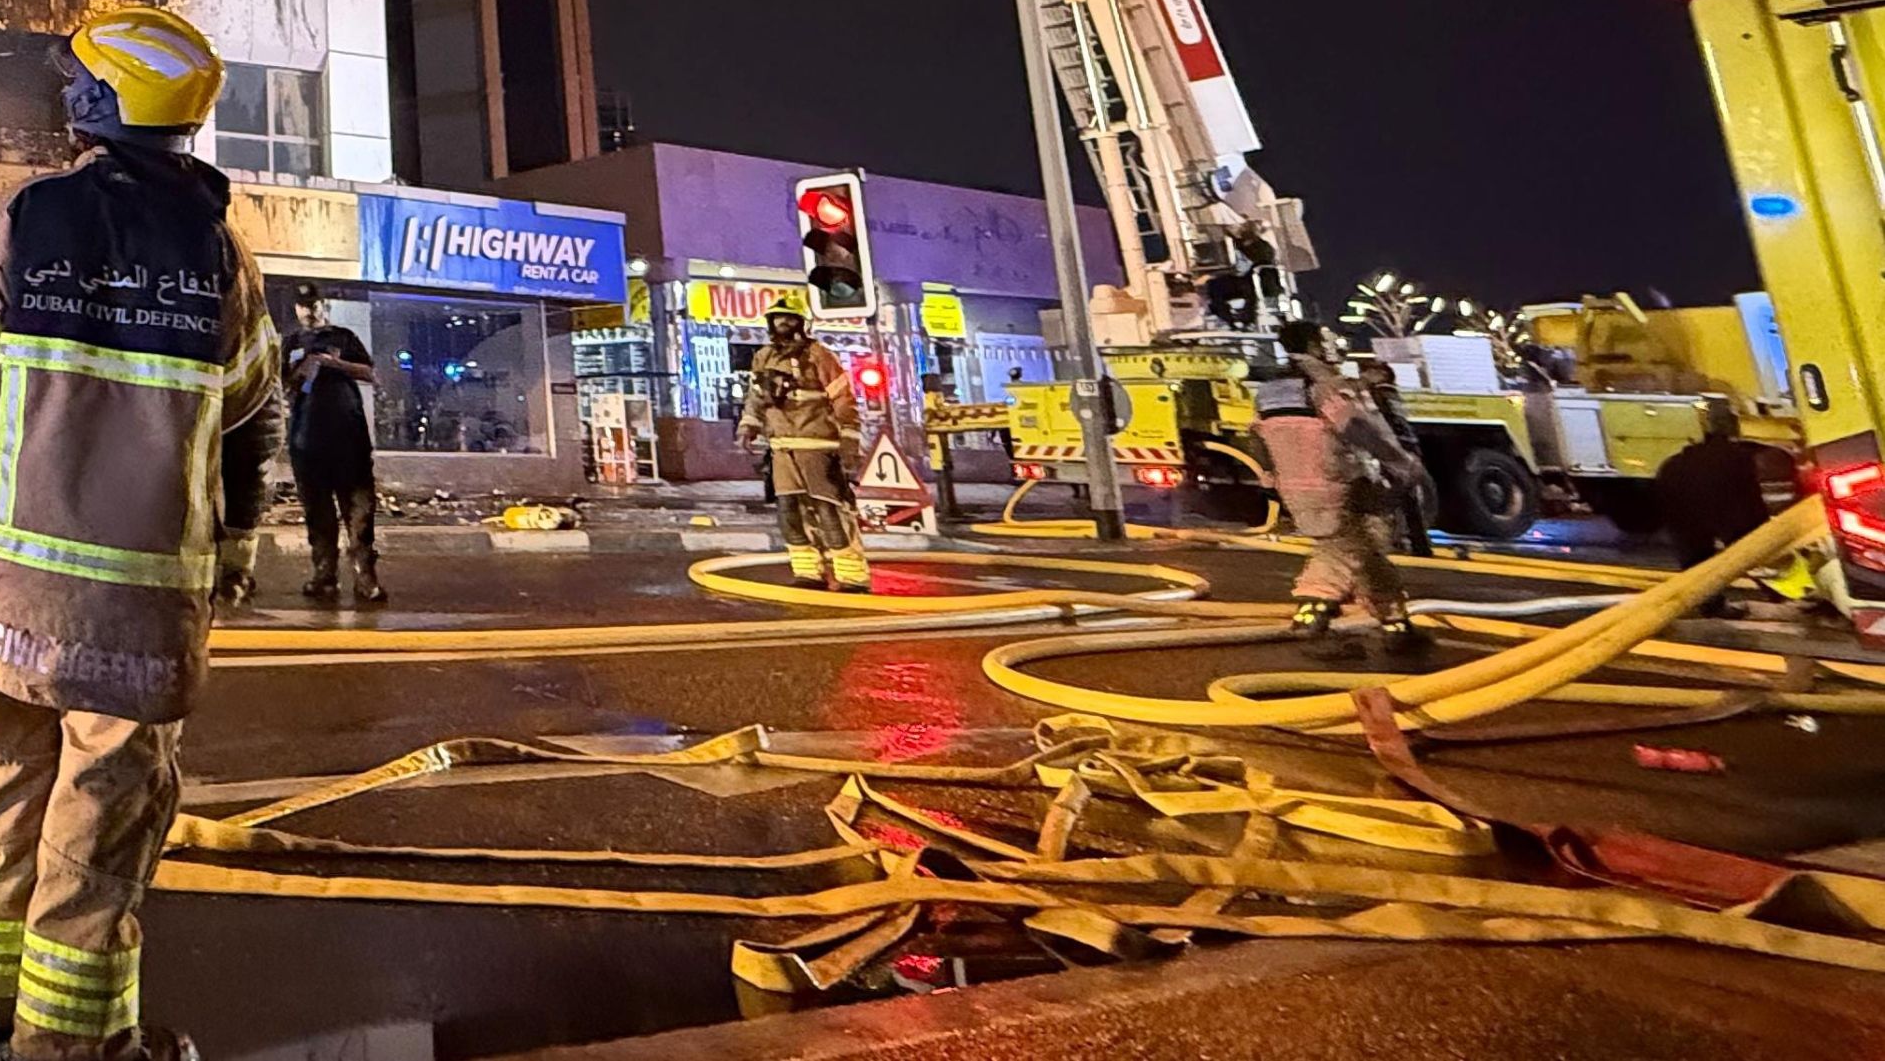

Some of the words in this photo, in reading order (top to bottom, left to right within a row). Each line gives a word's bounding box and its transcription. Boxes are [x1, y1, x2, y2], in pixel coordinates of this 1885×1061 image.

[447, 224, 595, 268] HIGHWAY
[23, 258, 72, 287] دبي
[521, 264, 557, 281] RENT
[558, 269, 571, 281] A
[572, 268, 600, 284] CAR
[21, 293, 83, 315] DUBAI
[86, 300, 132, 325] CIVIL
[135, 308, 223, 336] DEFENCE
